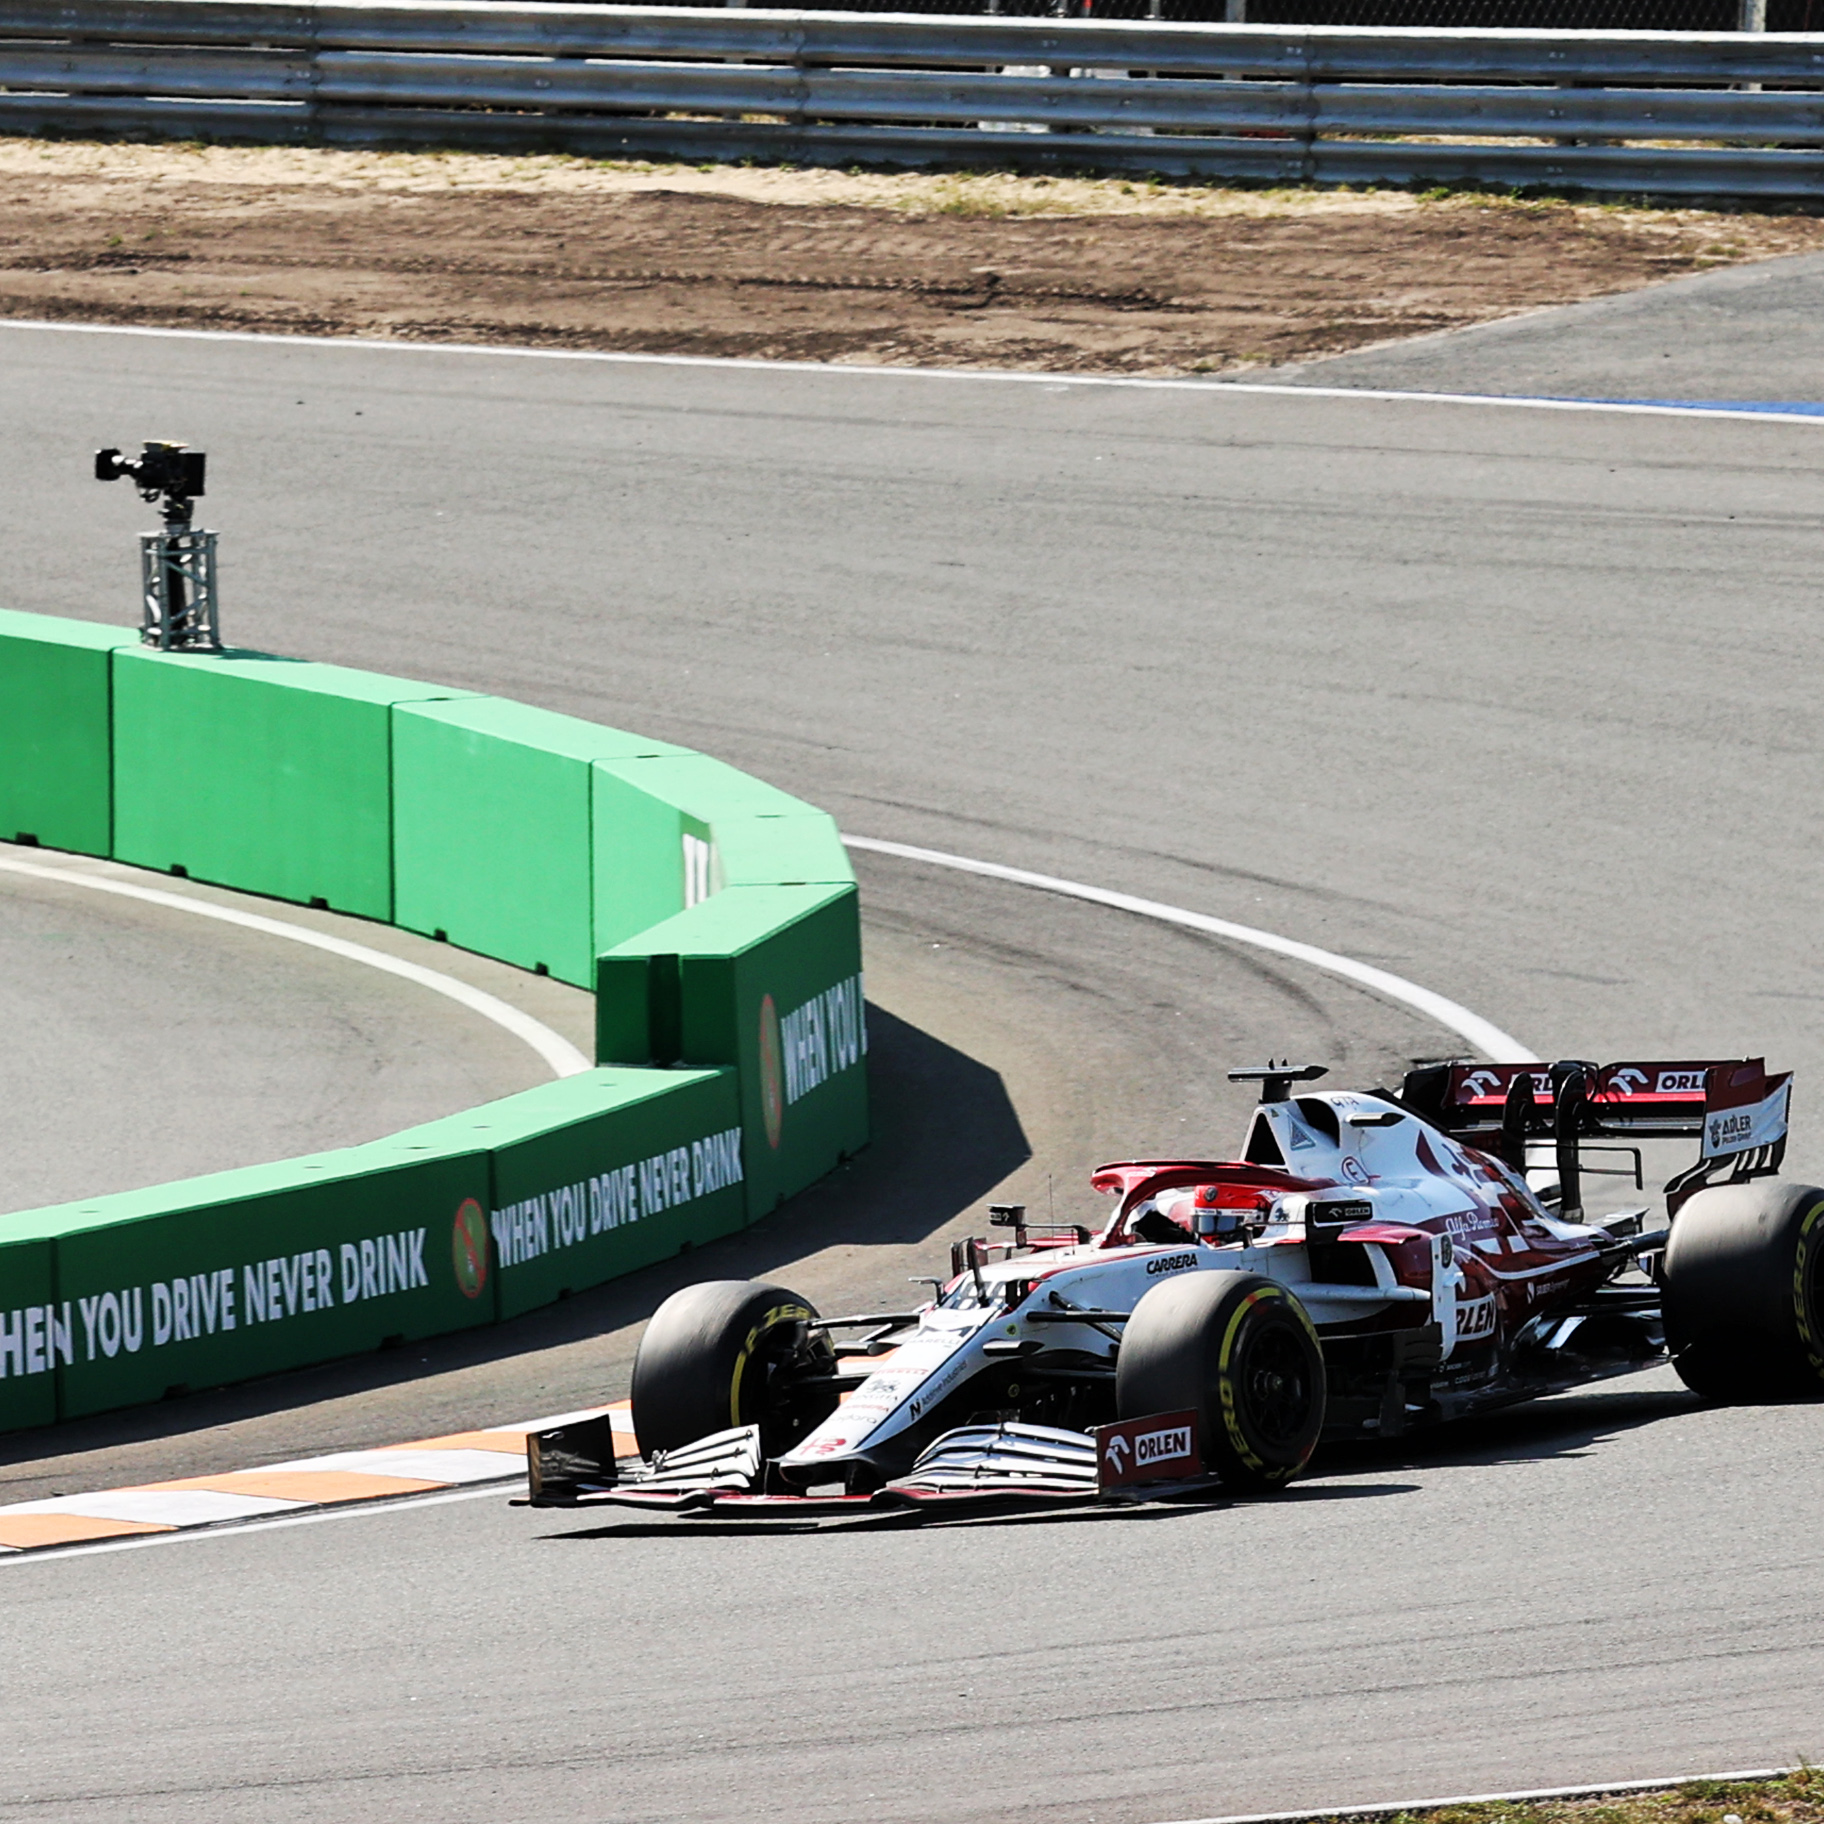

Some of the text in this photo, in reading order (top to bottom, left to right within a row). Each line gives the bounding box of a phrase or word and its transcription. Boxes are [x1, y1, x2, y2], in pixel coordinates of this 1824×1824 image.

[781, 994, 828, 1106] WHEN
[825, 975, 859, 1074] YOU
[1722, 1115, 1752, 1134] ADLER
[490, 1126, 744, 1270] WHEN YOU DRIVE NEVER DRINK
[1146, 1253, 1198, 1274] CARRERA
[80, 1285, 144, 1360] YOU
[152, 1267, 234, 1347] DRIVE
[243, 1241, 335, 1323] NEVER
[341, 1227, 429, 1302] DRINK
[1456, 1298, 1494, 1334] RLEN
[1137, 1429, 1187, 1460] ORLEN
